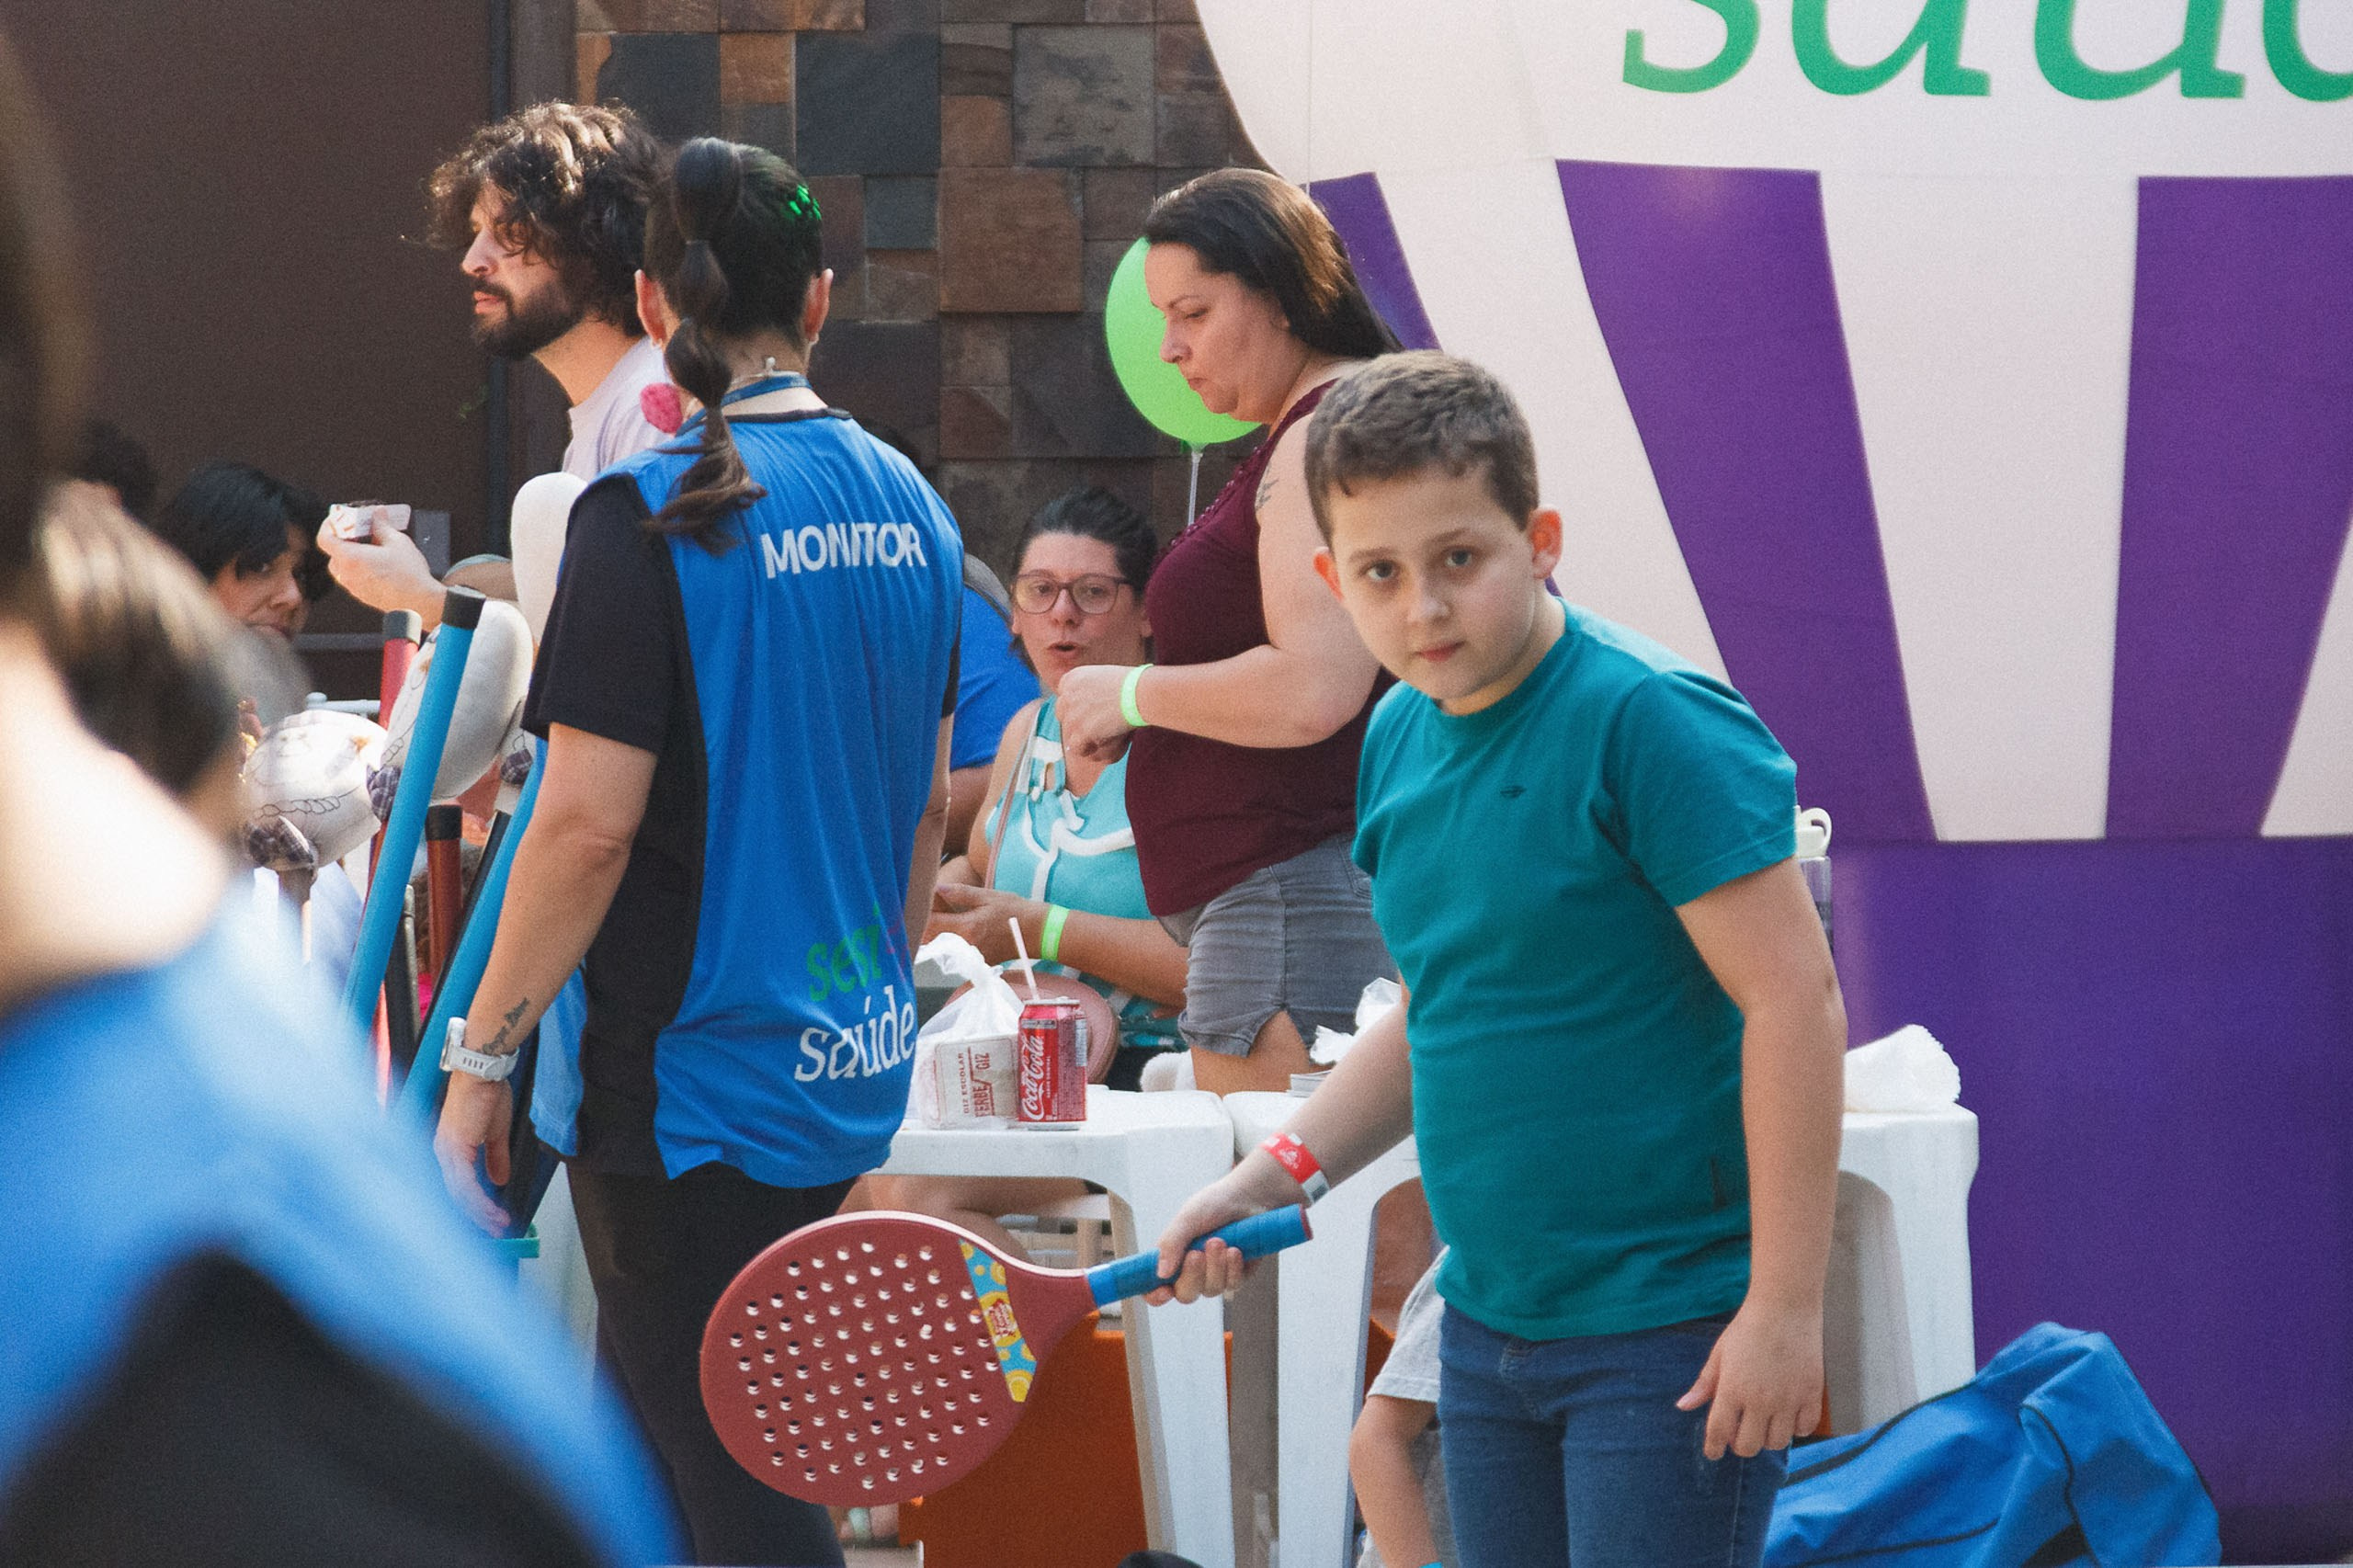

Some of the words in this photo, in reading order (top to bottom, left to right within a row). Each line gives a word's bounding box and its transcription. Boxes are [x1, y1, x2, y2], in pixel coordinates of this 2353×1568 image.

[760, 522, 927, 579] MONITOR
[794, 984, 915, 1082] saúde
[958, 1052, 968, 1096] ESCOLAR
[975, 1052, 990, 1071] GIZ
